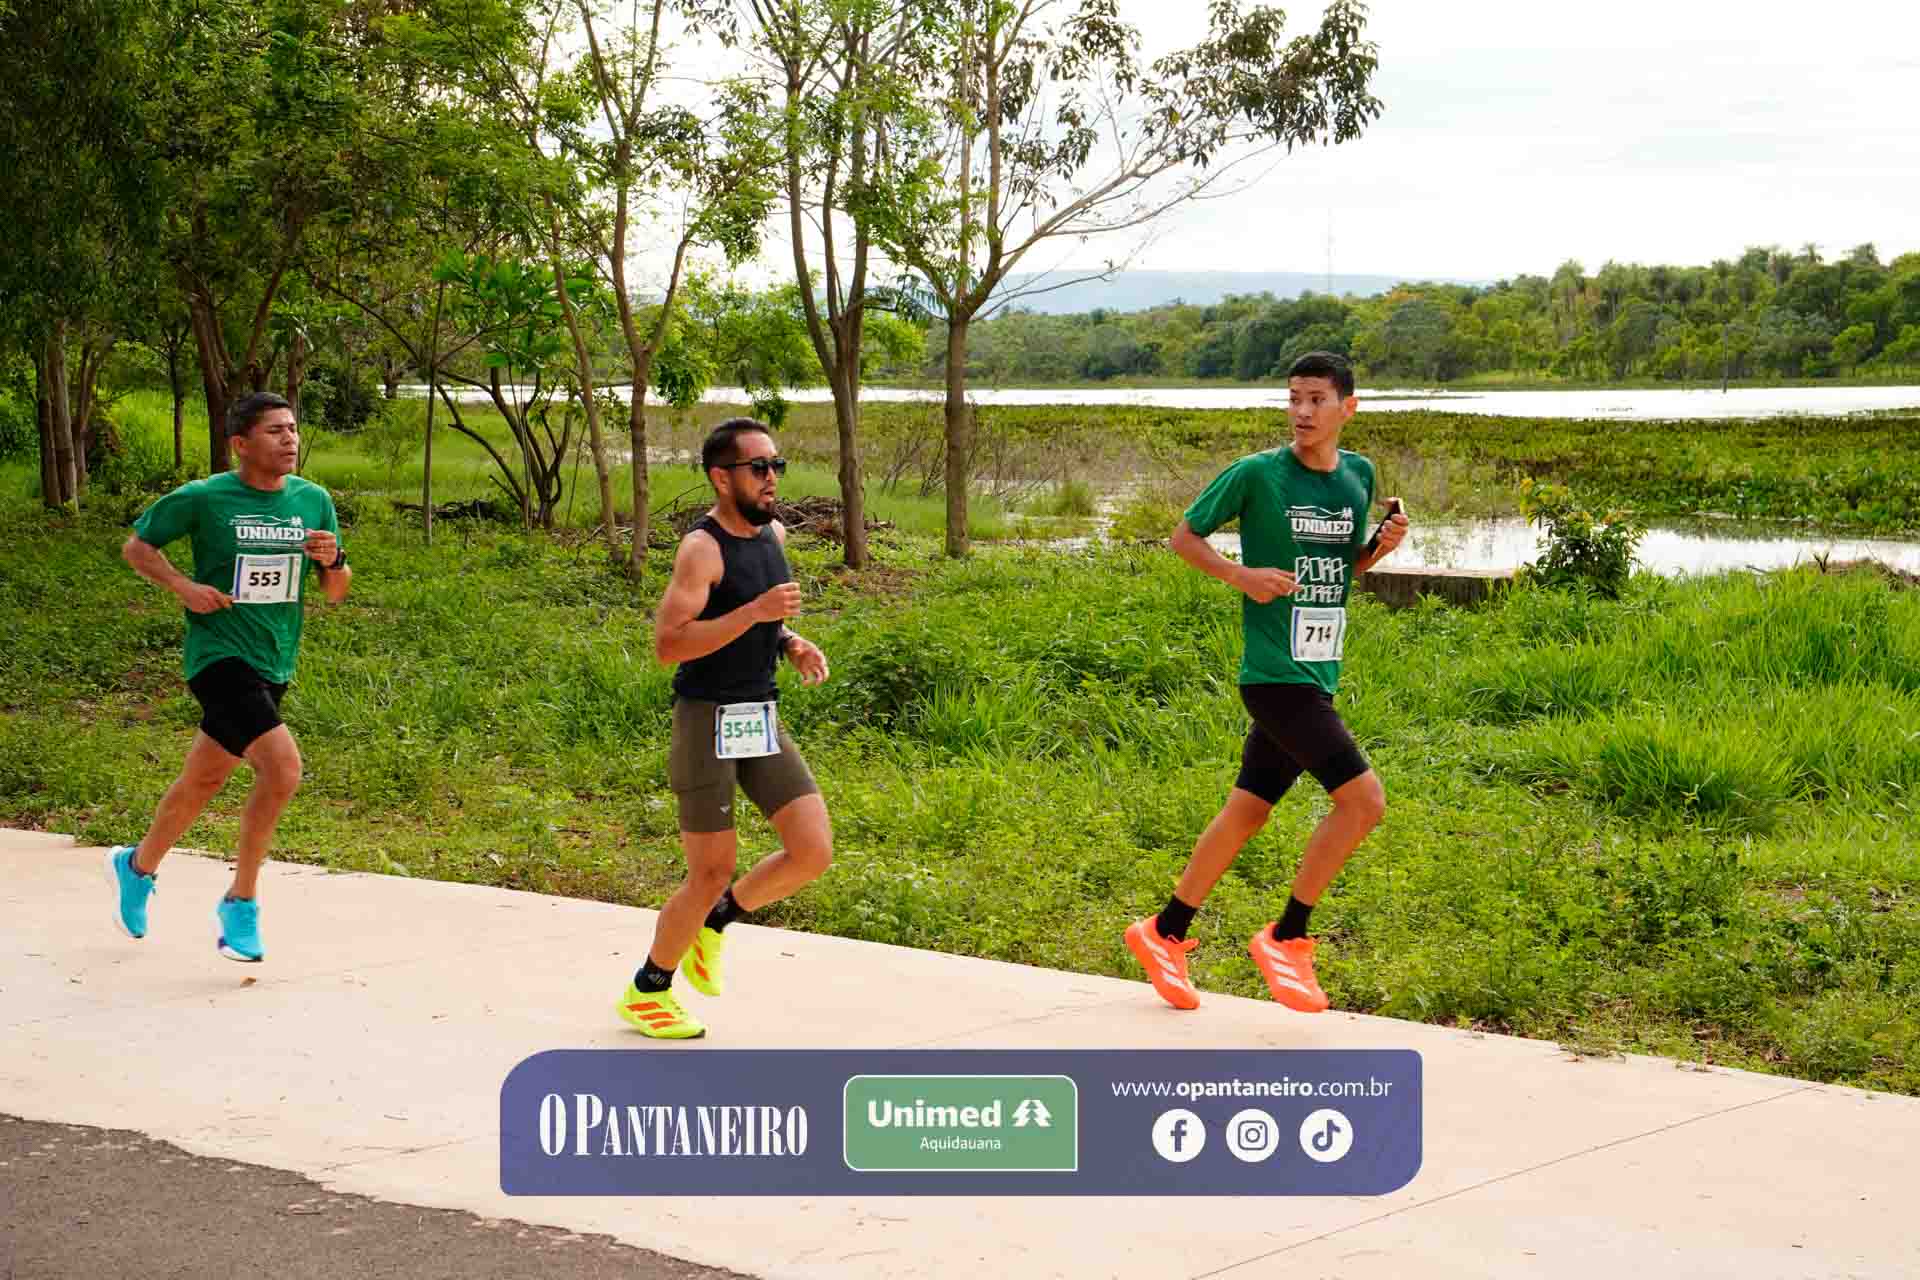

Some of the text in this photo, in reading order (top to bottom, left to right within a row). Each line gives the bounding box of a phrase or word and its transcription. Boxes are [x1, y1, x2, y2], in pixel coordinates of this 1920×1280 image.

[236, 526, 304, 540] UNIMED
[1291, 518, 1353, 534] UNIMED
[248, 571, 281, 587] 553
[724, 720, 763, 737] 3544
